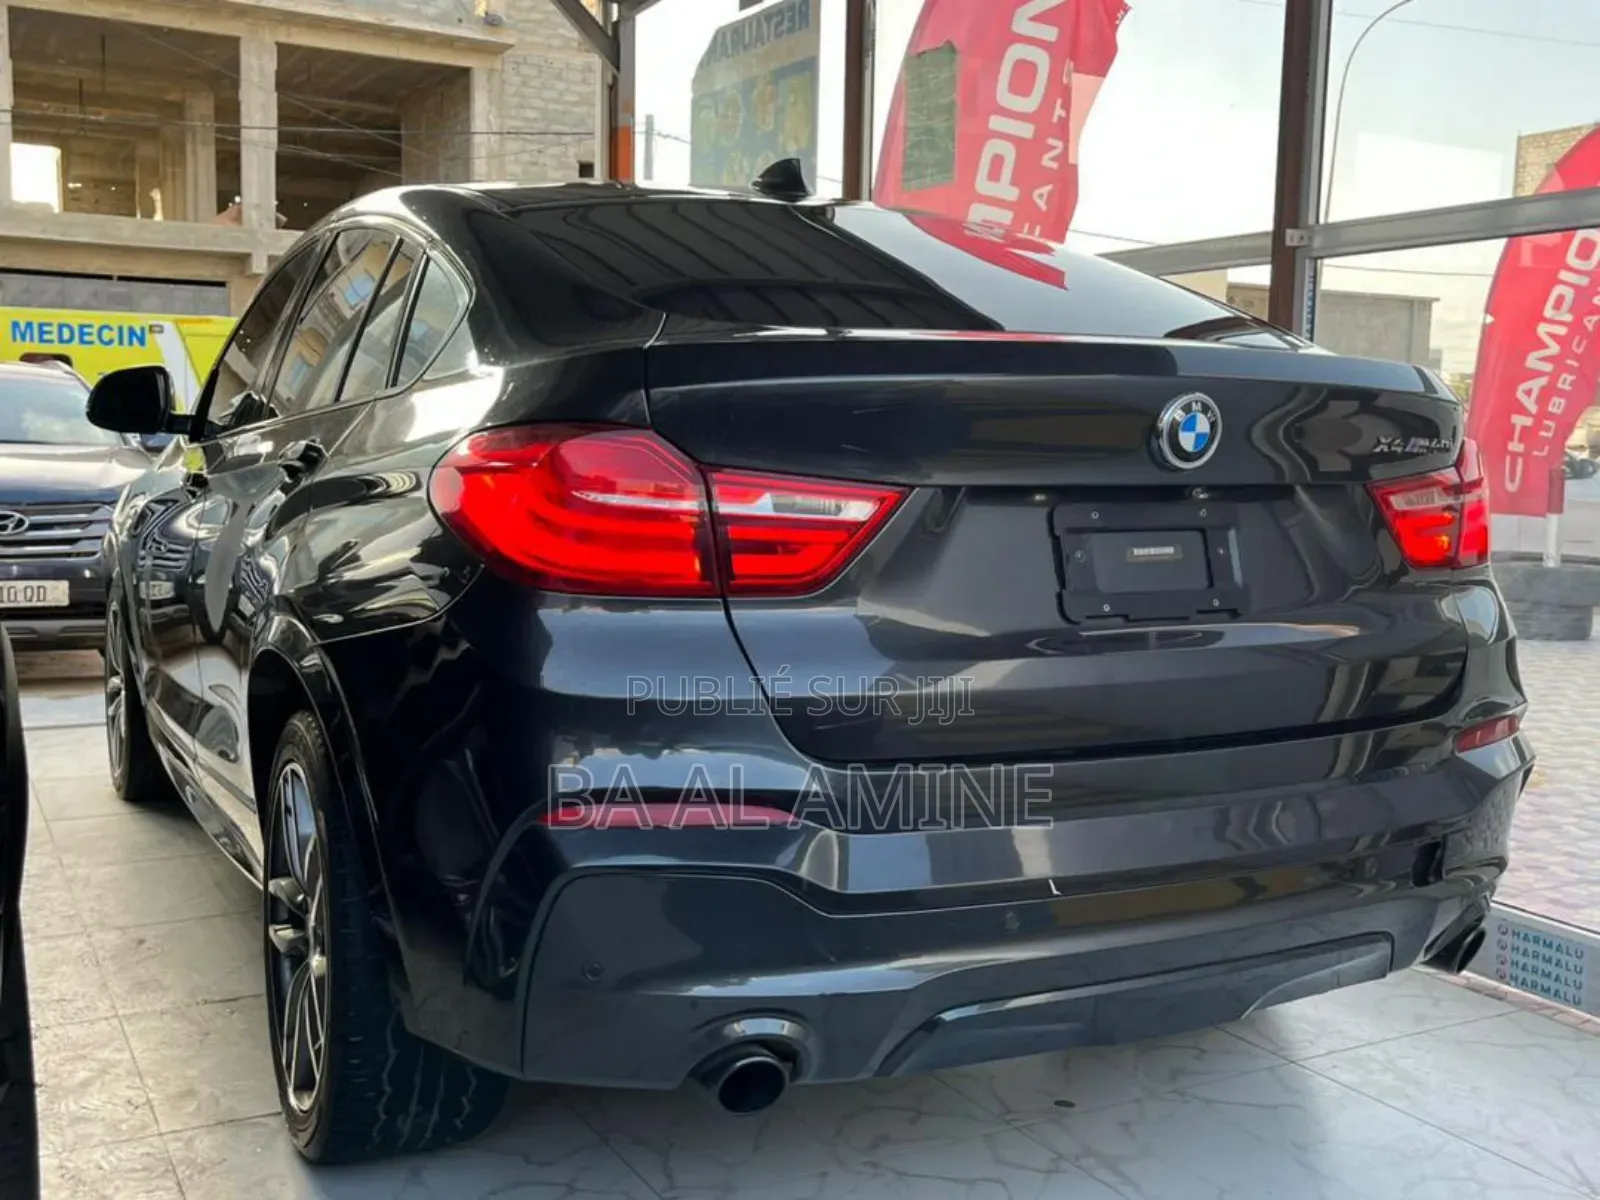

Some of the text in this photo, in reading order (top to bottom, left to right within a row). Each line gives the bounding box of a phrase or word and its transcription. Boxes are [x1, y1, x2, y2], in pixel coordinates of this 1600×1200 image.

[11, 320, 147, 347] MEDECIN
[1174, 401, 1216, 423] BMW
[1511, 928, 1584, 960] HARMALU
[1511, 943, 1583, 974] HARMALU
[1509, 973, 1582, 1006] HARMALU
[1510, 958, 1583, 990] HARMALU
